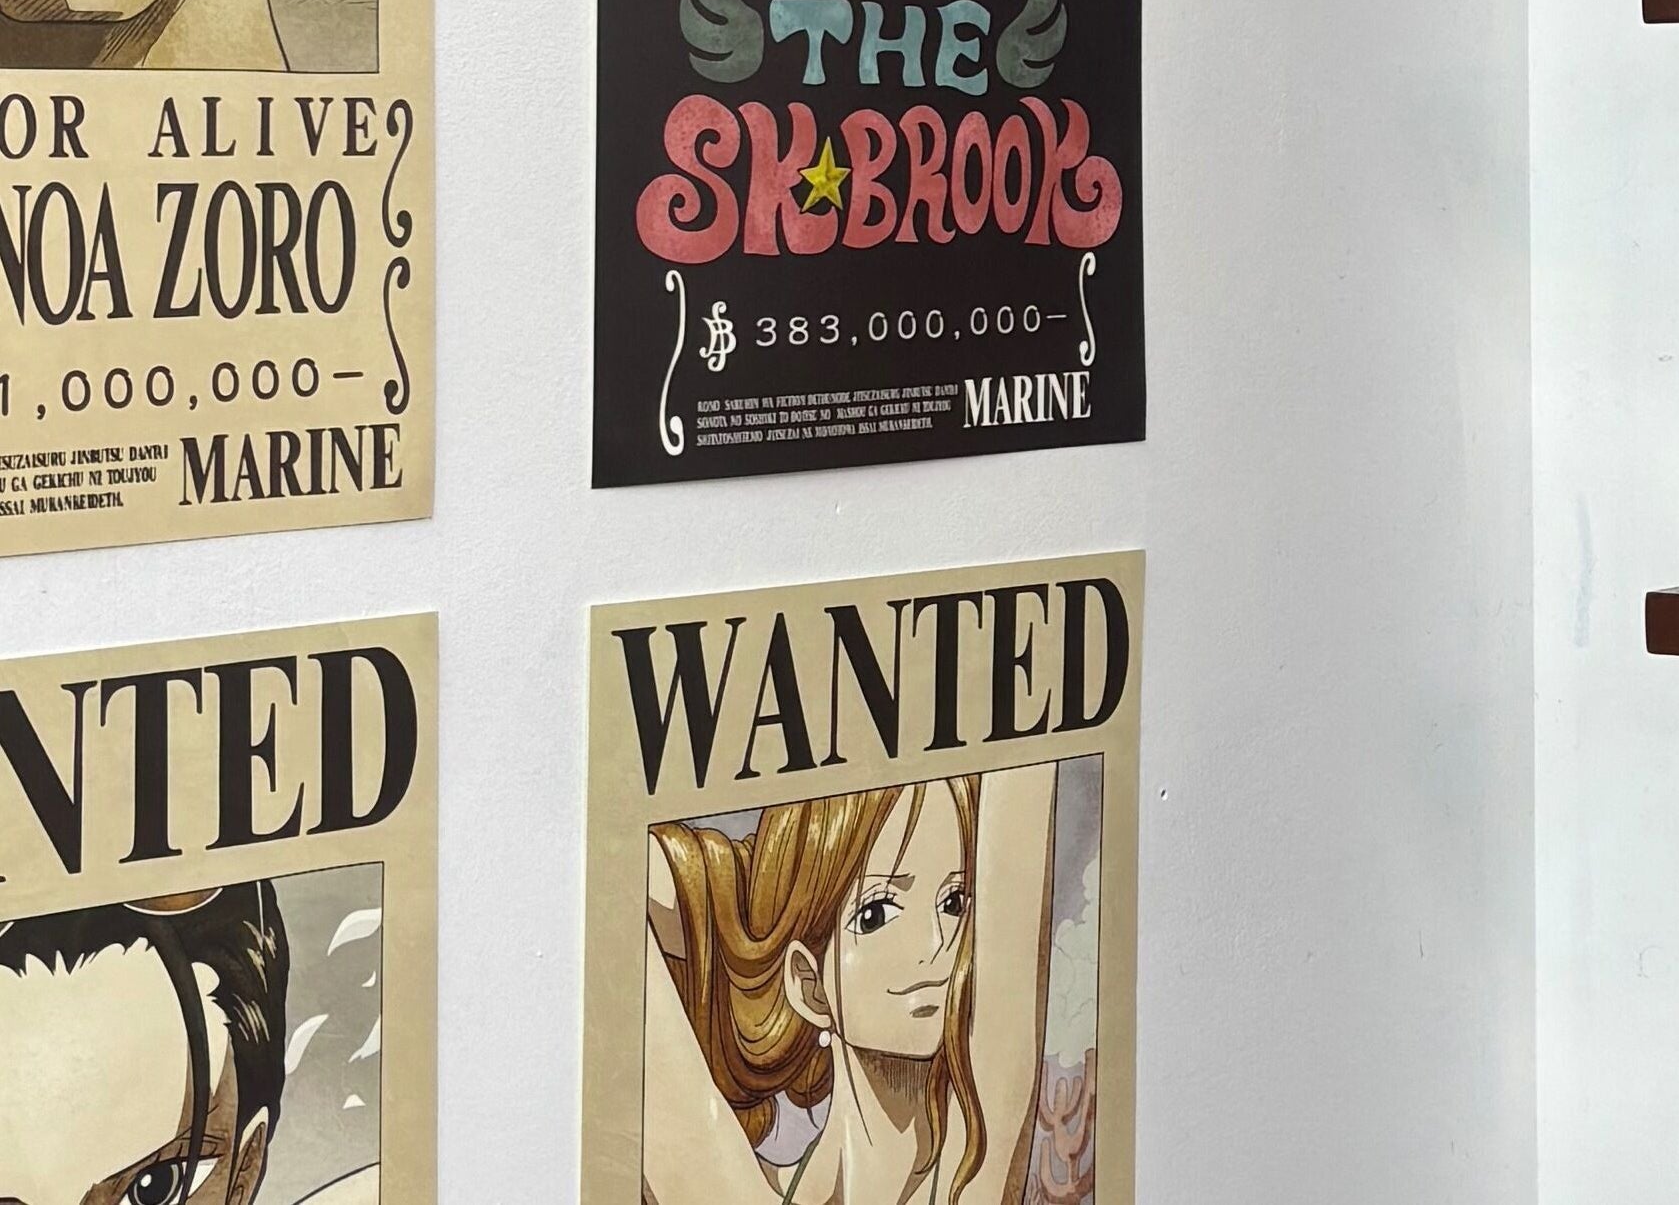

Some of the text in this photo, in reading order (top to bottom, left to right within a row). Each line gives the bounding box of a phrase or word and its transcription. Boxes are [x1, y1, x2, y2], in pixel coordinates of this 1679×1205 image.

[0, 93, 379, 159] OR ALIVE
[153, 179, 357, 319] ZORO
[962, 370, 1091, 429] MARINE
[12, 476, 28, 492] GA
[179, 423, 402, 506] MARINE
[611, 577, 1130, 795] WANTED
